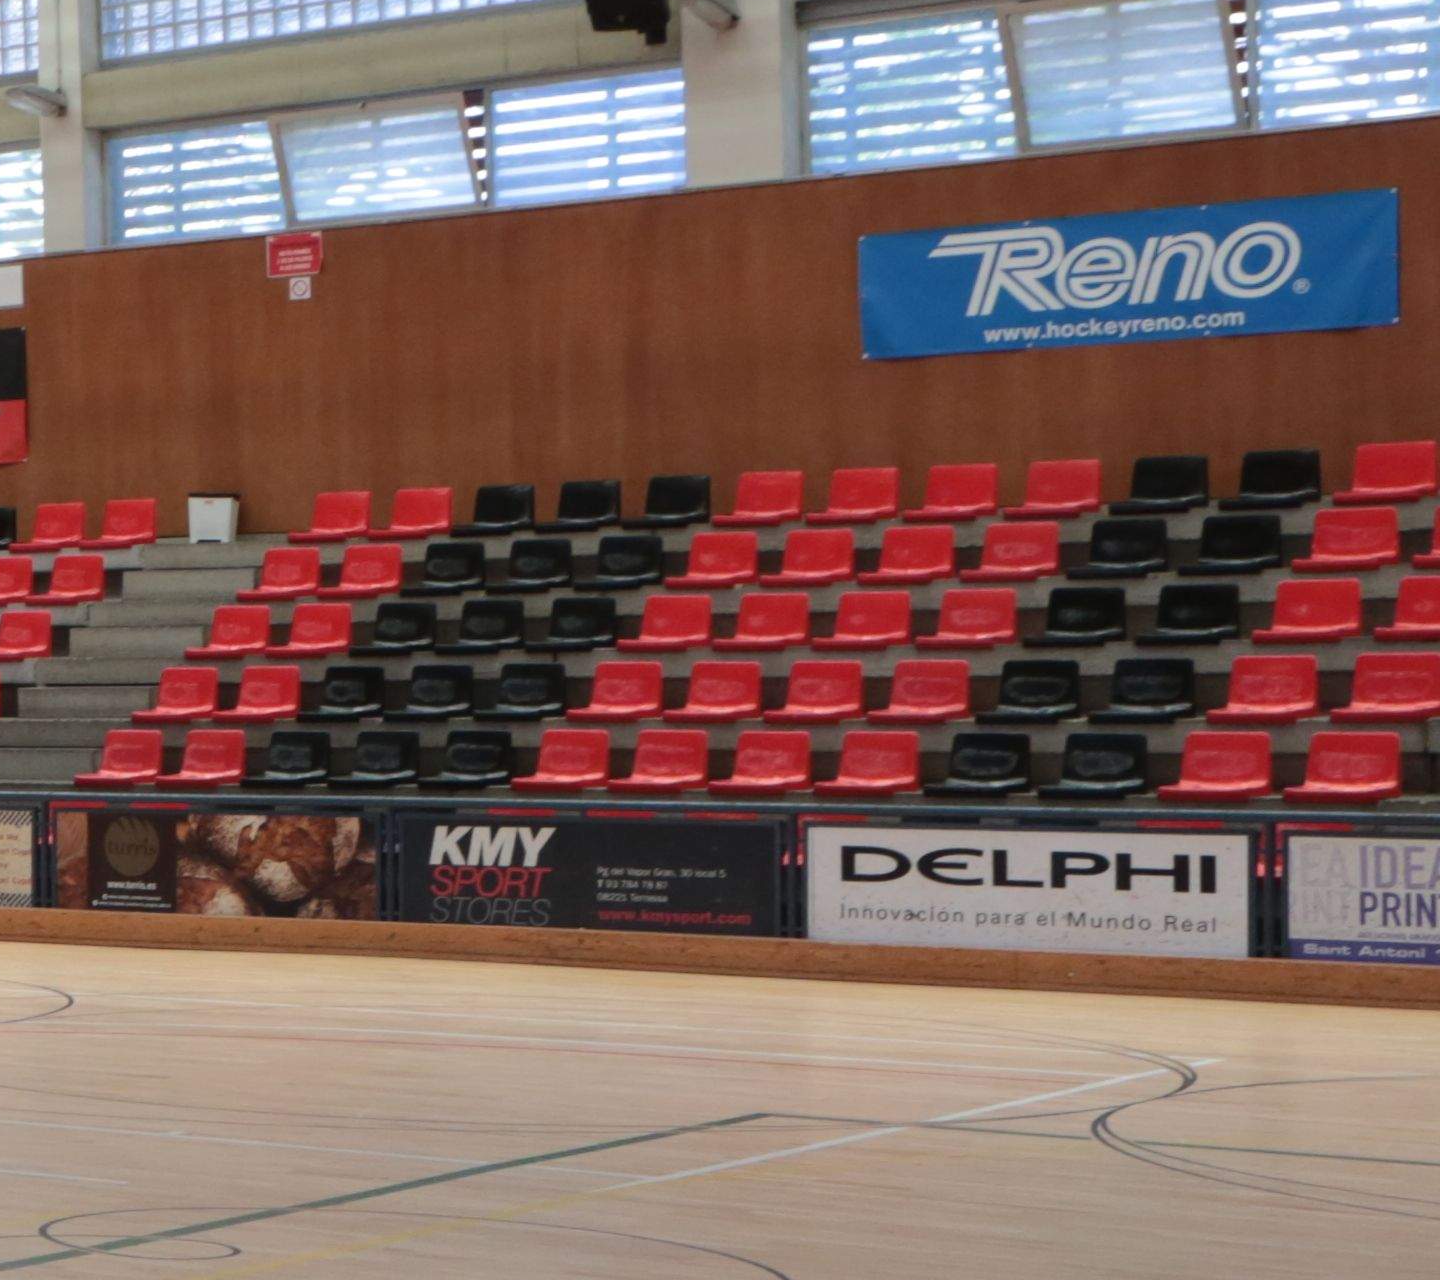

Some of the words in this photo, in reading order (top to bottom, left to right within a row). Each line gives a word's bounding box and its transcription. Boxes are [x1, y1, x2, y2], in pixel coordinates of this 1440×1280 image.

[928, 221, 1301, 316] Reno
[984, 309, 1245, 343] www.hockeyreno.com
[429, 825, 557, 866] KMY
[429, 865, 553, 898] SPORT
[840, 845, 1216, 894] DELPHI
[430, 897, 551, 927] STORES
[839, 902, 964, 924] Innovación
[975, 910, 1025, 927] para
[1036, 910, 1056, 926] el
[1066, 911, 1151, 932] Mundo
[1163, 916, 1217, 933] Real
[1359, 891, 1440, 928] PRIN
[1303, 943, 1352, 956] Sant
[1358, 945, 1426, 958] Antoni
